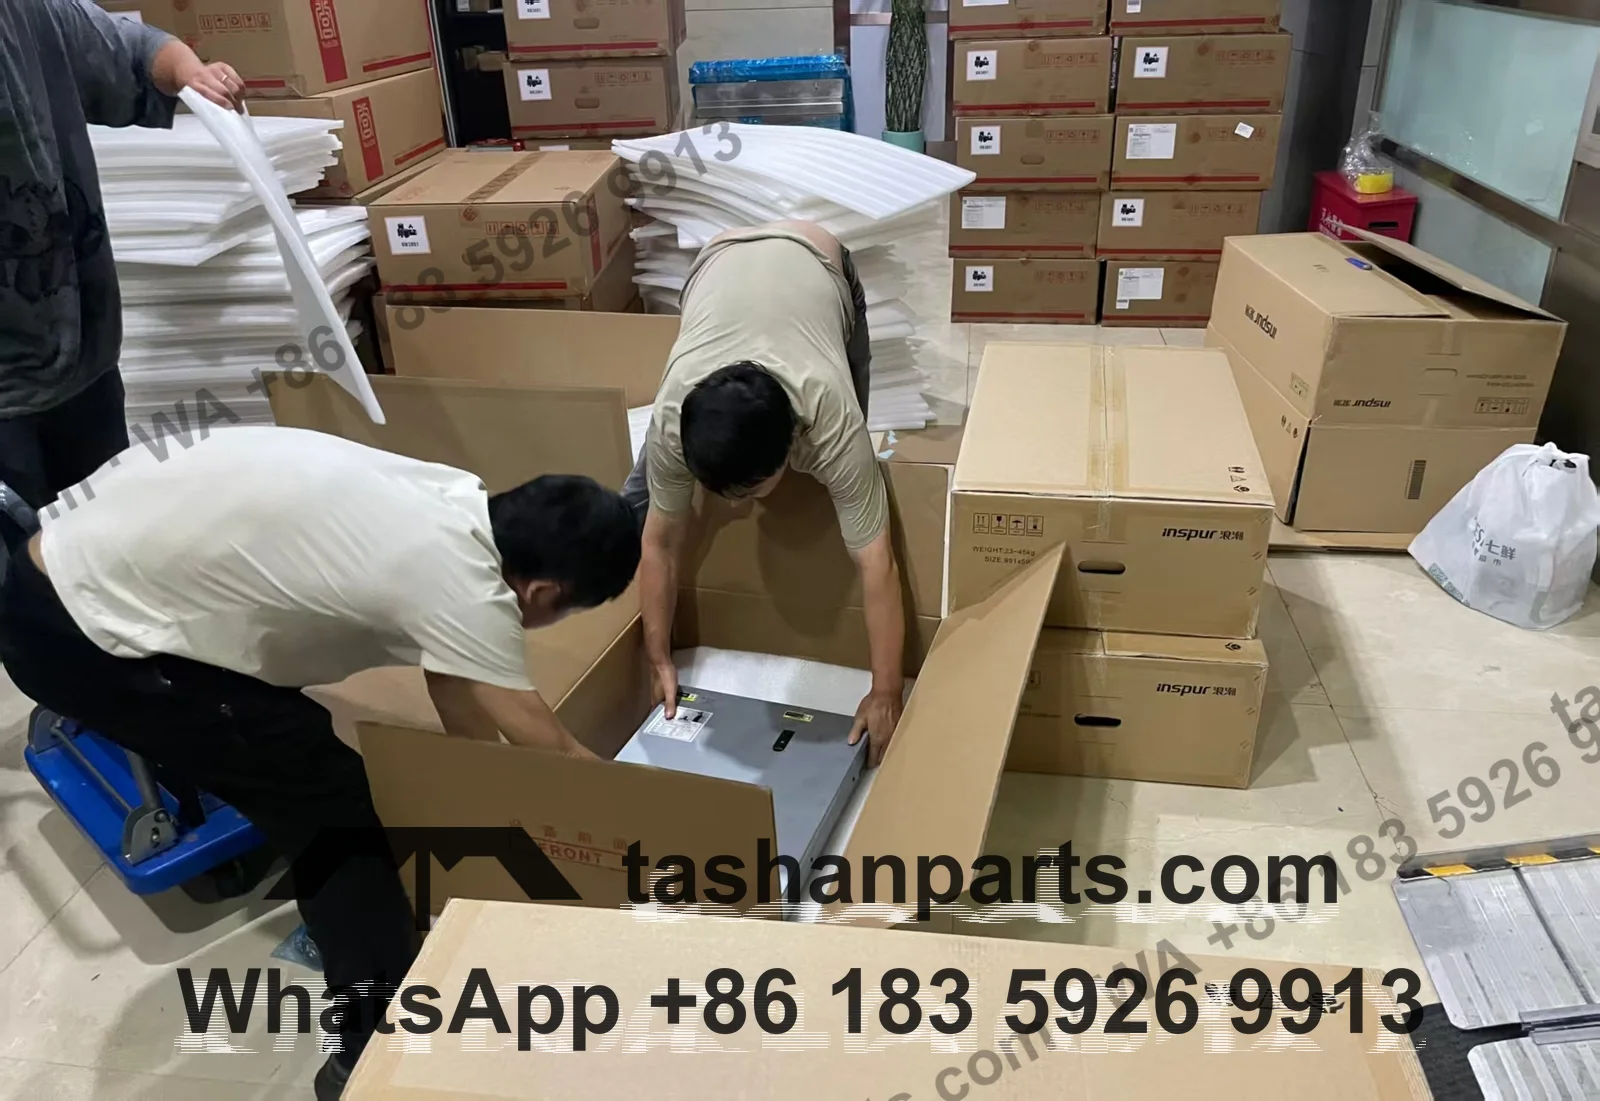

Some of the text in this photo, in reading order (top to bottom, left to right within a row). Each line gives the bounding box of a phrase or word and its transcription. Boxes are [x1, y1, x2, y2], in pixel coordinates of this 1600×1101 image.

[1162, 527, 1244, 541] inspur 浪潮
[1156, 683, 1211, 696] inspur
